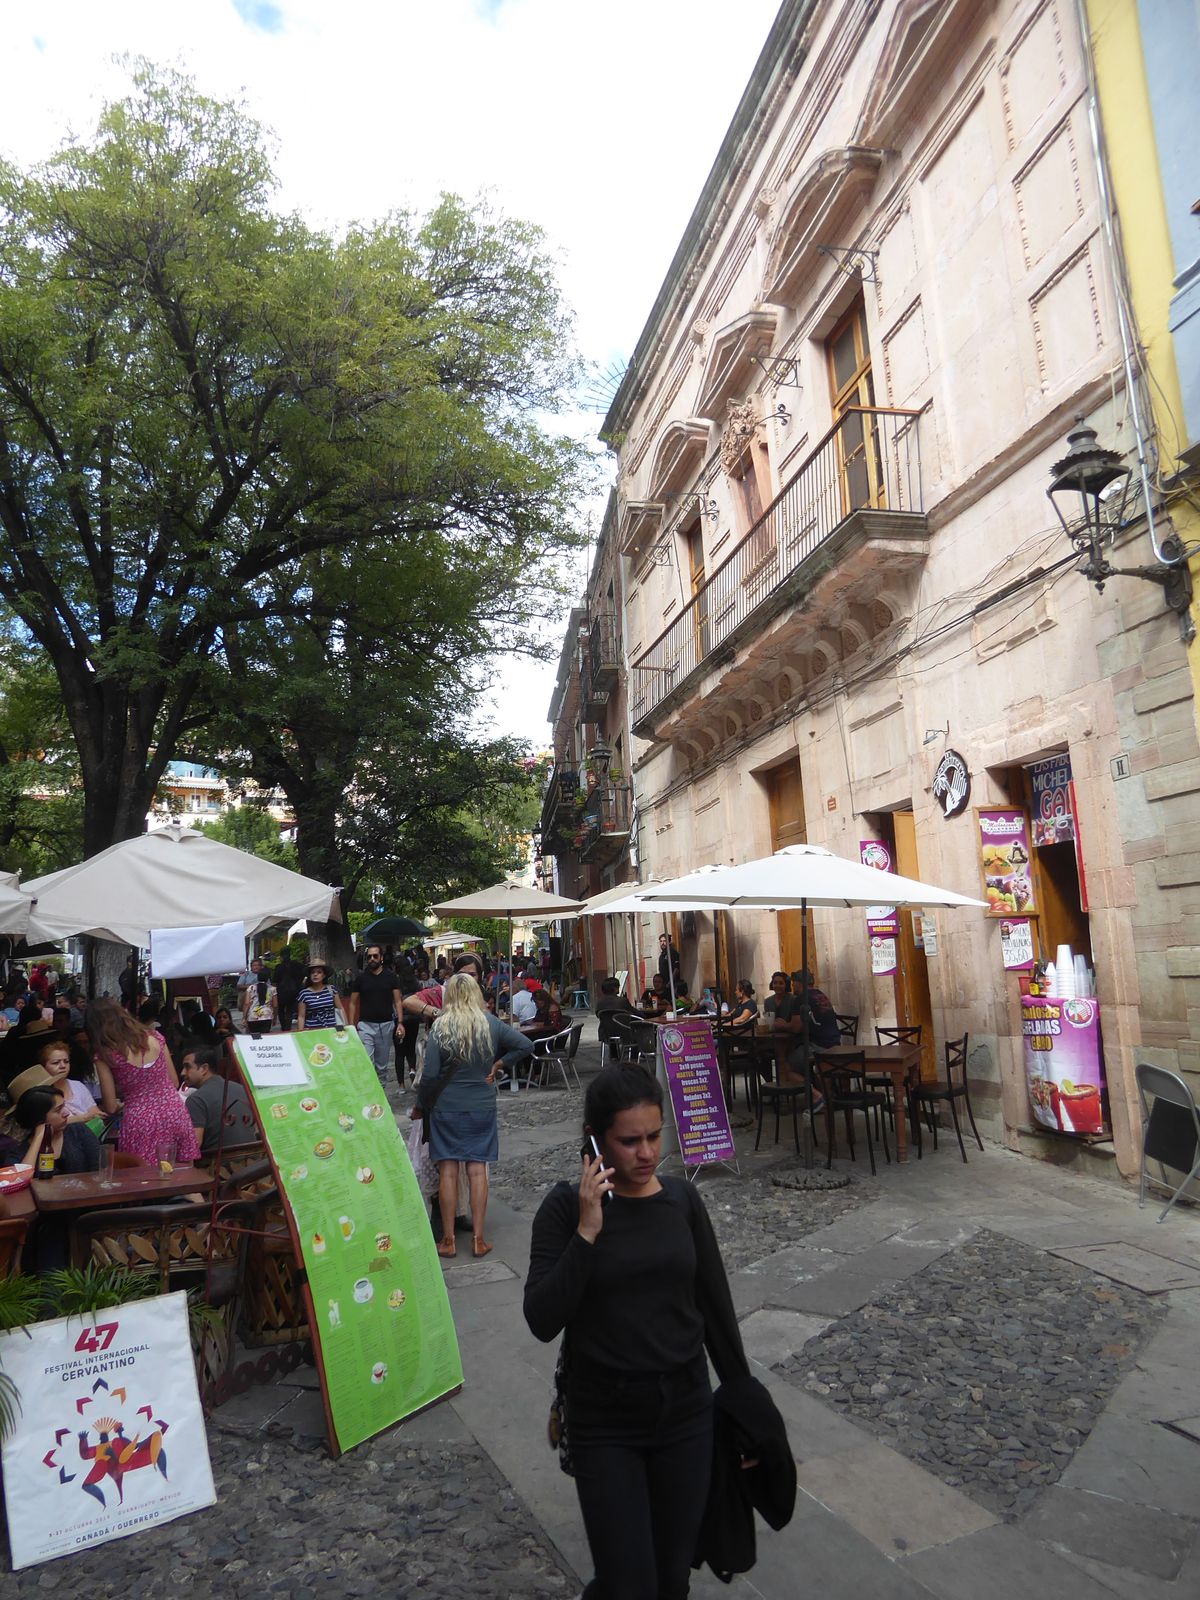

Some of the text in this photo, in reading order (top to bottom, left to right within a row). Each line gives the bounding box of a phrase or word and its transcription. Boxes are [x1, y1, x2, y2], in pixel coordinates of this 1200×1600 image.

[1034, 761, 1050, 773] LAS
[75, 1321, 119, 1353] 47
[44, 1343, 151, 1375] FESTIVAL INTERNACIONAL
[61, 1356, 136, 1382] CERVANTINO
[117, 1510, 160, 1531] GUERRERO
